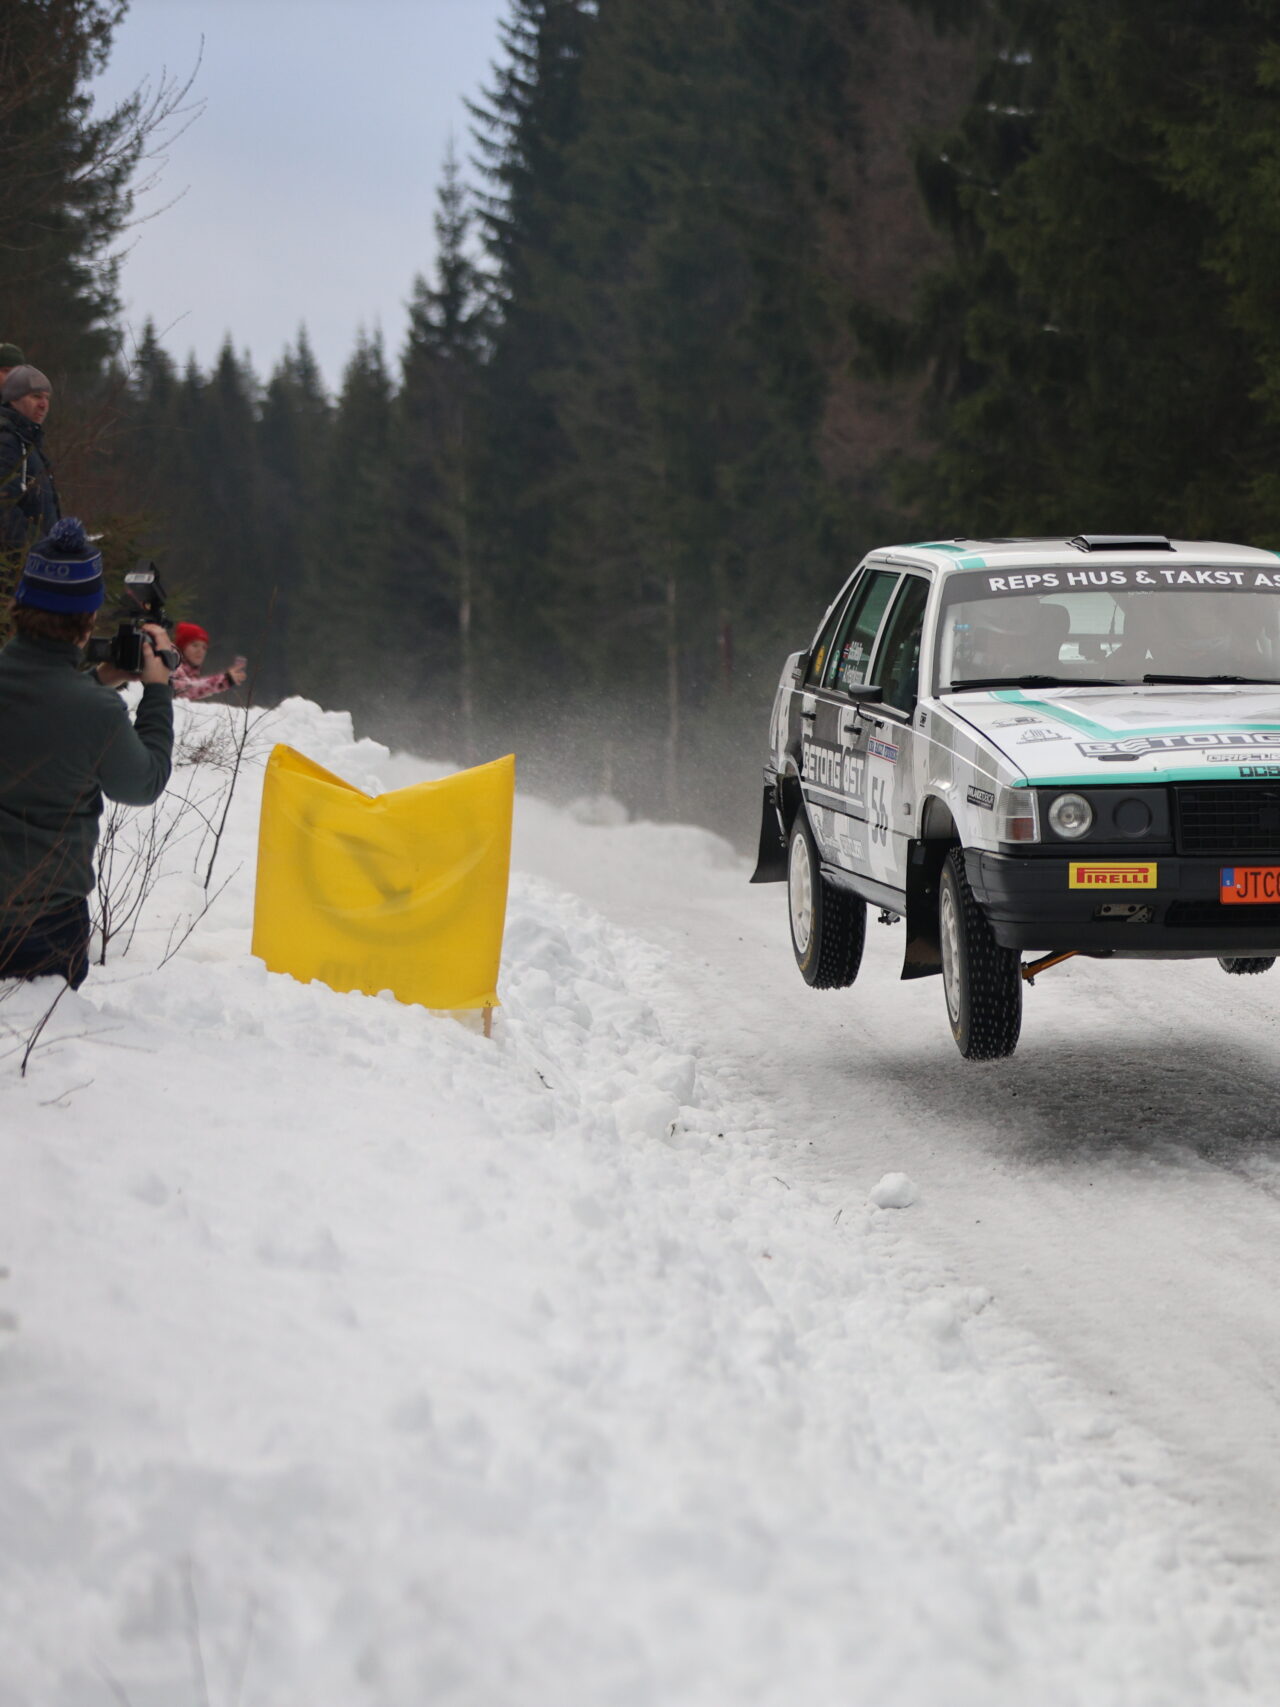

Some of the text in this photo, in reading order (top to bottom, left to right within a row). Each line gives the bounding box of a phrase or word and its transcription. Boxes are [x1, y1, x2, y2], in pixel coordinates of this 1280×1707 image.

[988, 573, 1060, 592] REPS
[1066, 570, 1127, 586] HUS
[1135, 570, 1157, 585] &
[1159, 570, 1245, 585] TAKST
[871, 776, 888, 847] 56
[1076, 867, 1149, 884] PIRELLI
